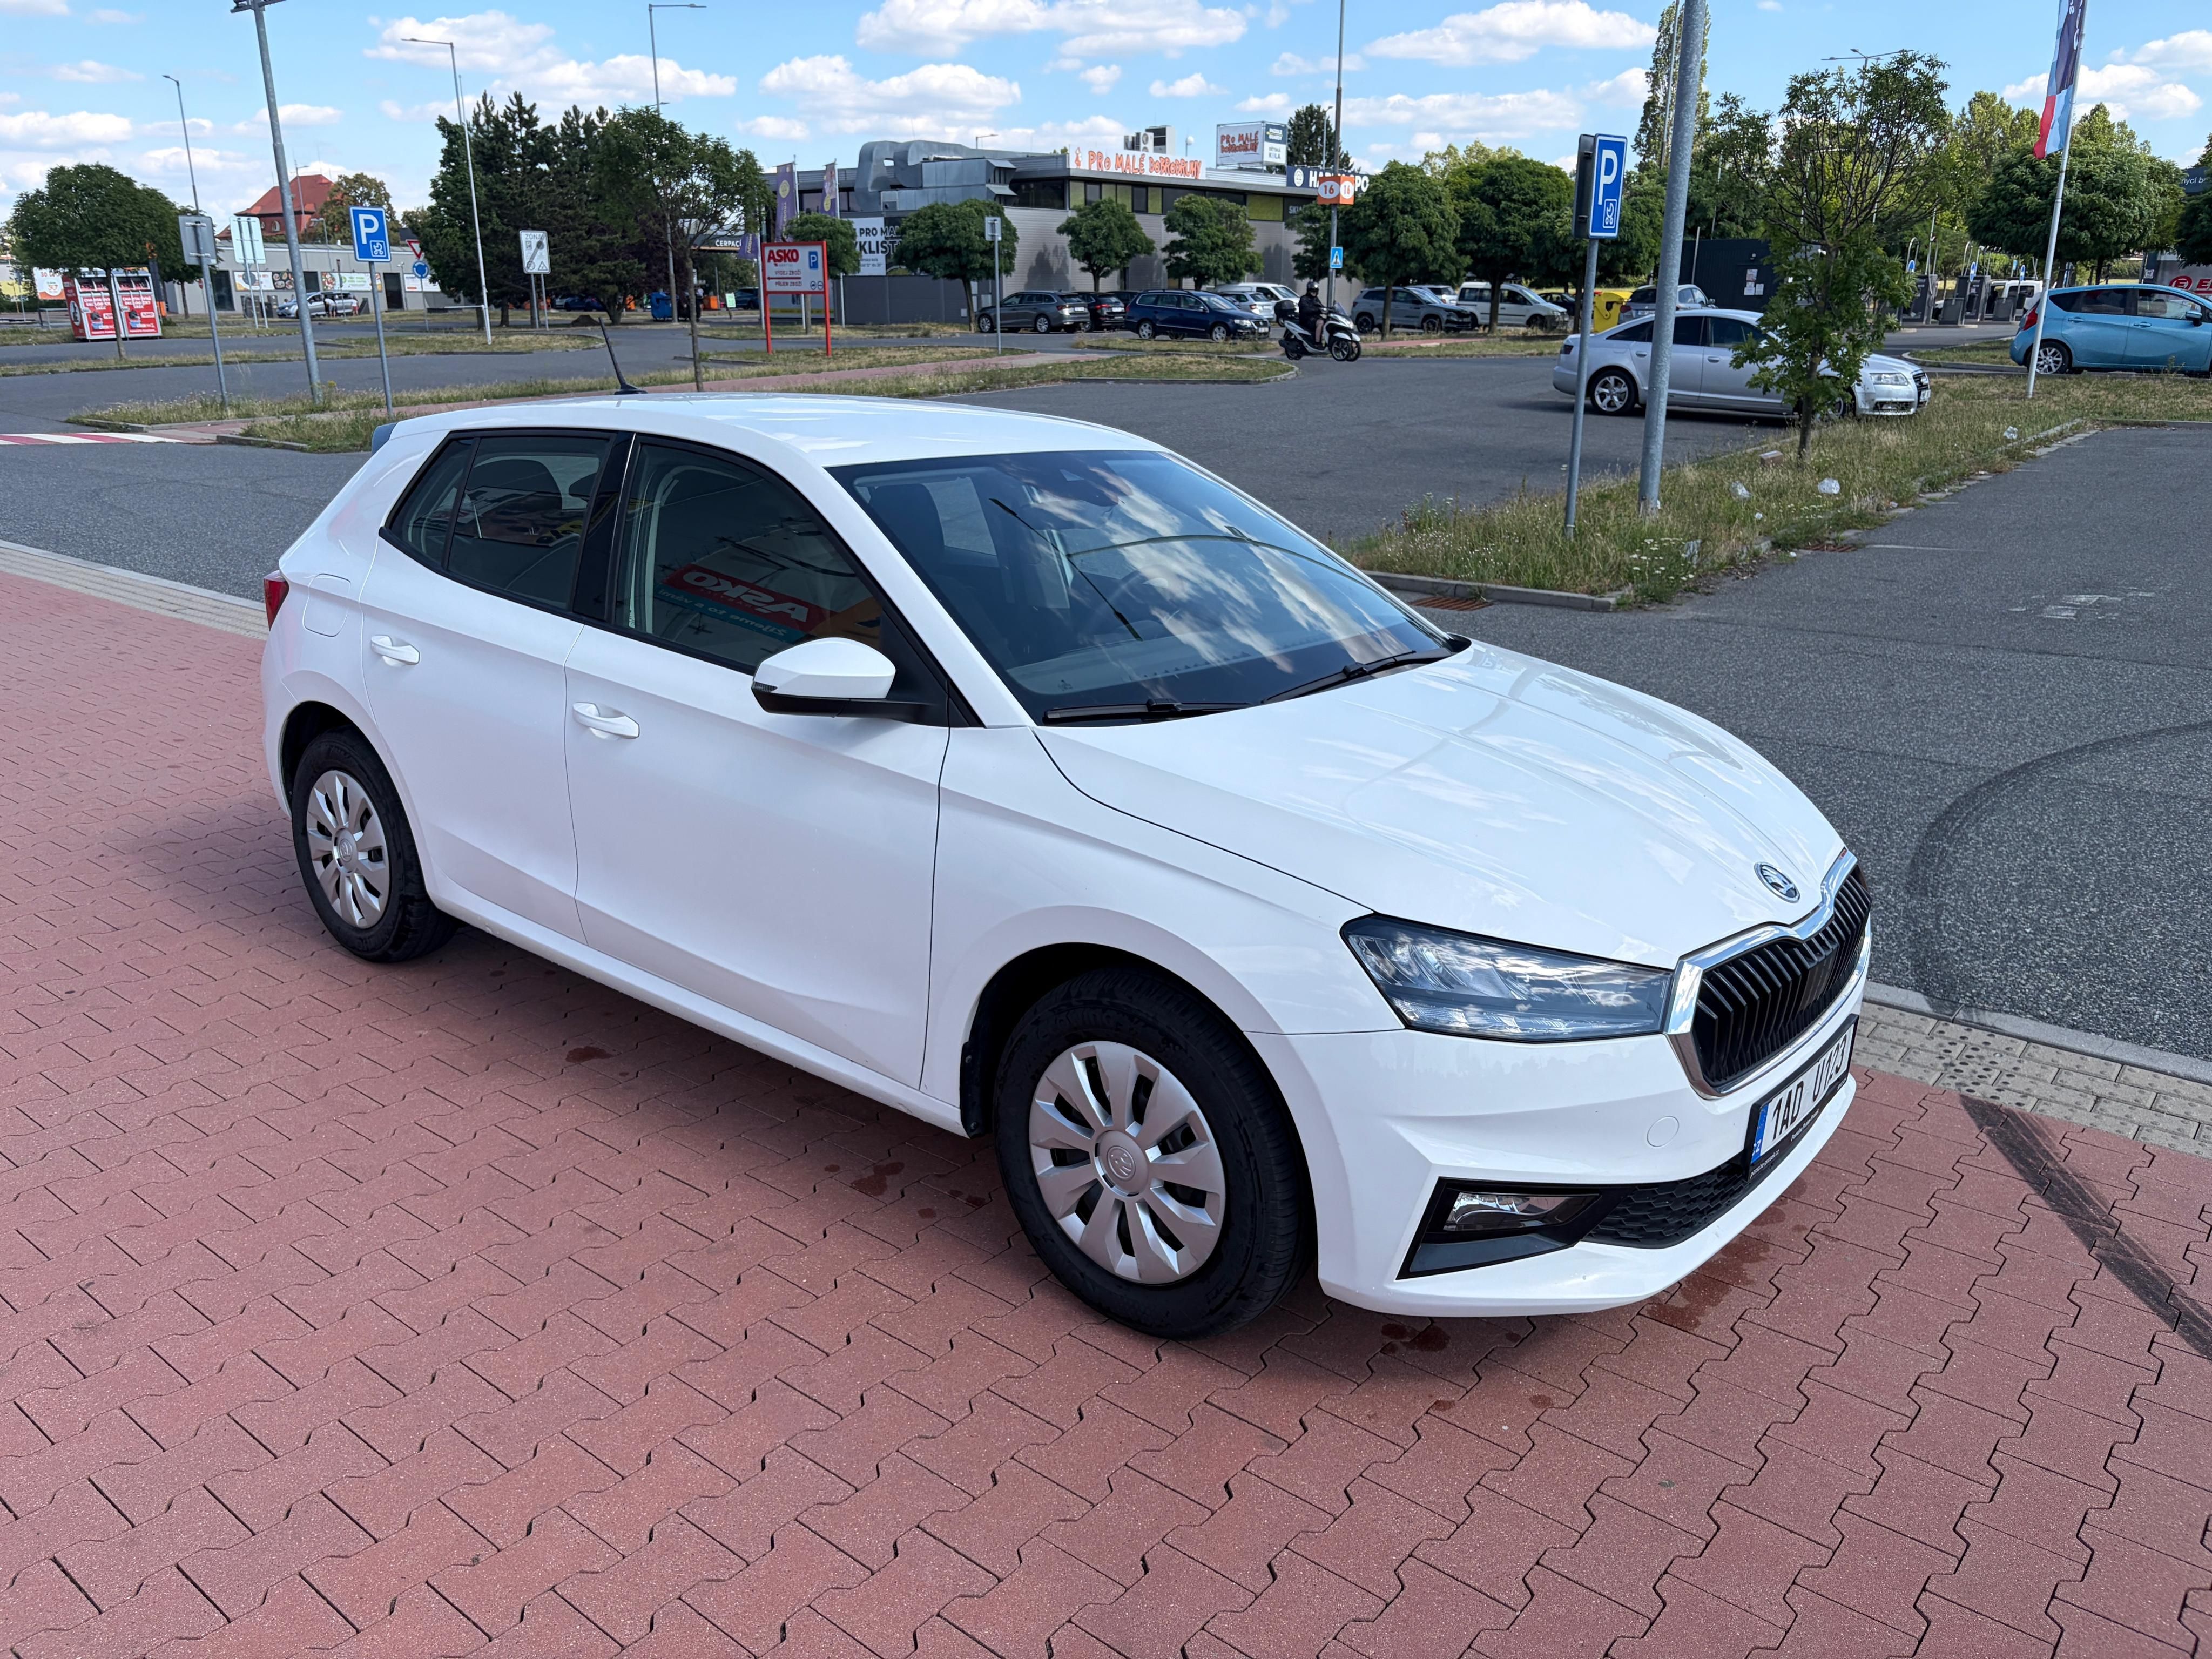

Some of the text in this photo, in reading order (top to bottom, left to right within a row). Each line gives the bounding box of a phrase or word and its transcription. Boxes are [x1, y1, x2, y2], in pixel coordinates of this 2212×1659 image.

[1220, 134, 1235, 144] PRO
[1238, 131, 1259, 141] MALÉ
[1088, 150, 1202, 180] PRO MALÉ DOBRODRUHY
[1598, 149, 1618, 205] P
[1324, 185, 1334, 195] 16
[1344, 185, 1350, 195] 16
[359, 214, 379, 244] P
[859, 227, 878, 237] PRO
[715, 239, 742, 247] ČERPACÍ
[767, 249, 799, 264] ASKO
[810, 254, 817, 267] P
[1772, 1034, 1847, 1141] 1AD U123
